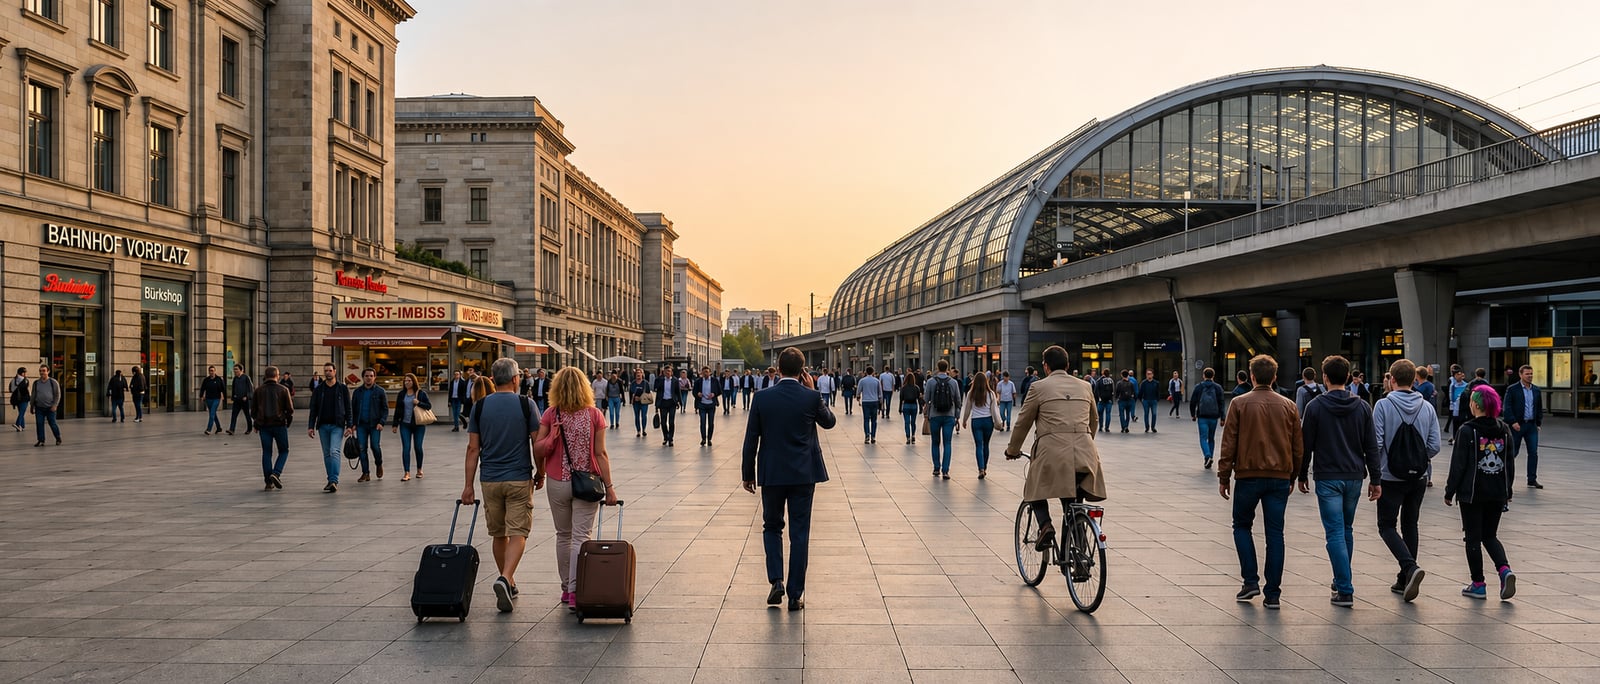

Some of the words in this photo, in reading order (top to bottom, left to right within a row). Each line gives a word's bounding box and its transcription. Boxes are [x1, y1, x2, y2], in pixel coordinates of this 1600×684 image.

[48, 224, 122, 253] BAHNHOF
[126, 237, 190, 265] VORPLATZ
[144, 286, 183, 306] Bürkshop
[344, 306, 446, 319] WURST-IMBISS
[462, 307, 499, 325] WURST-IMBISS
